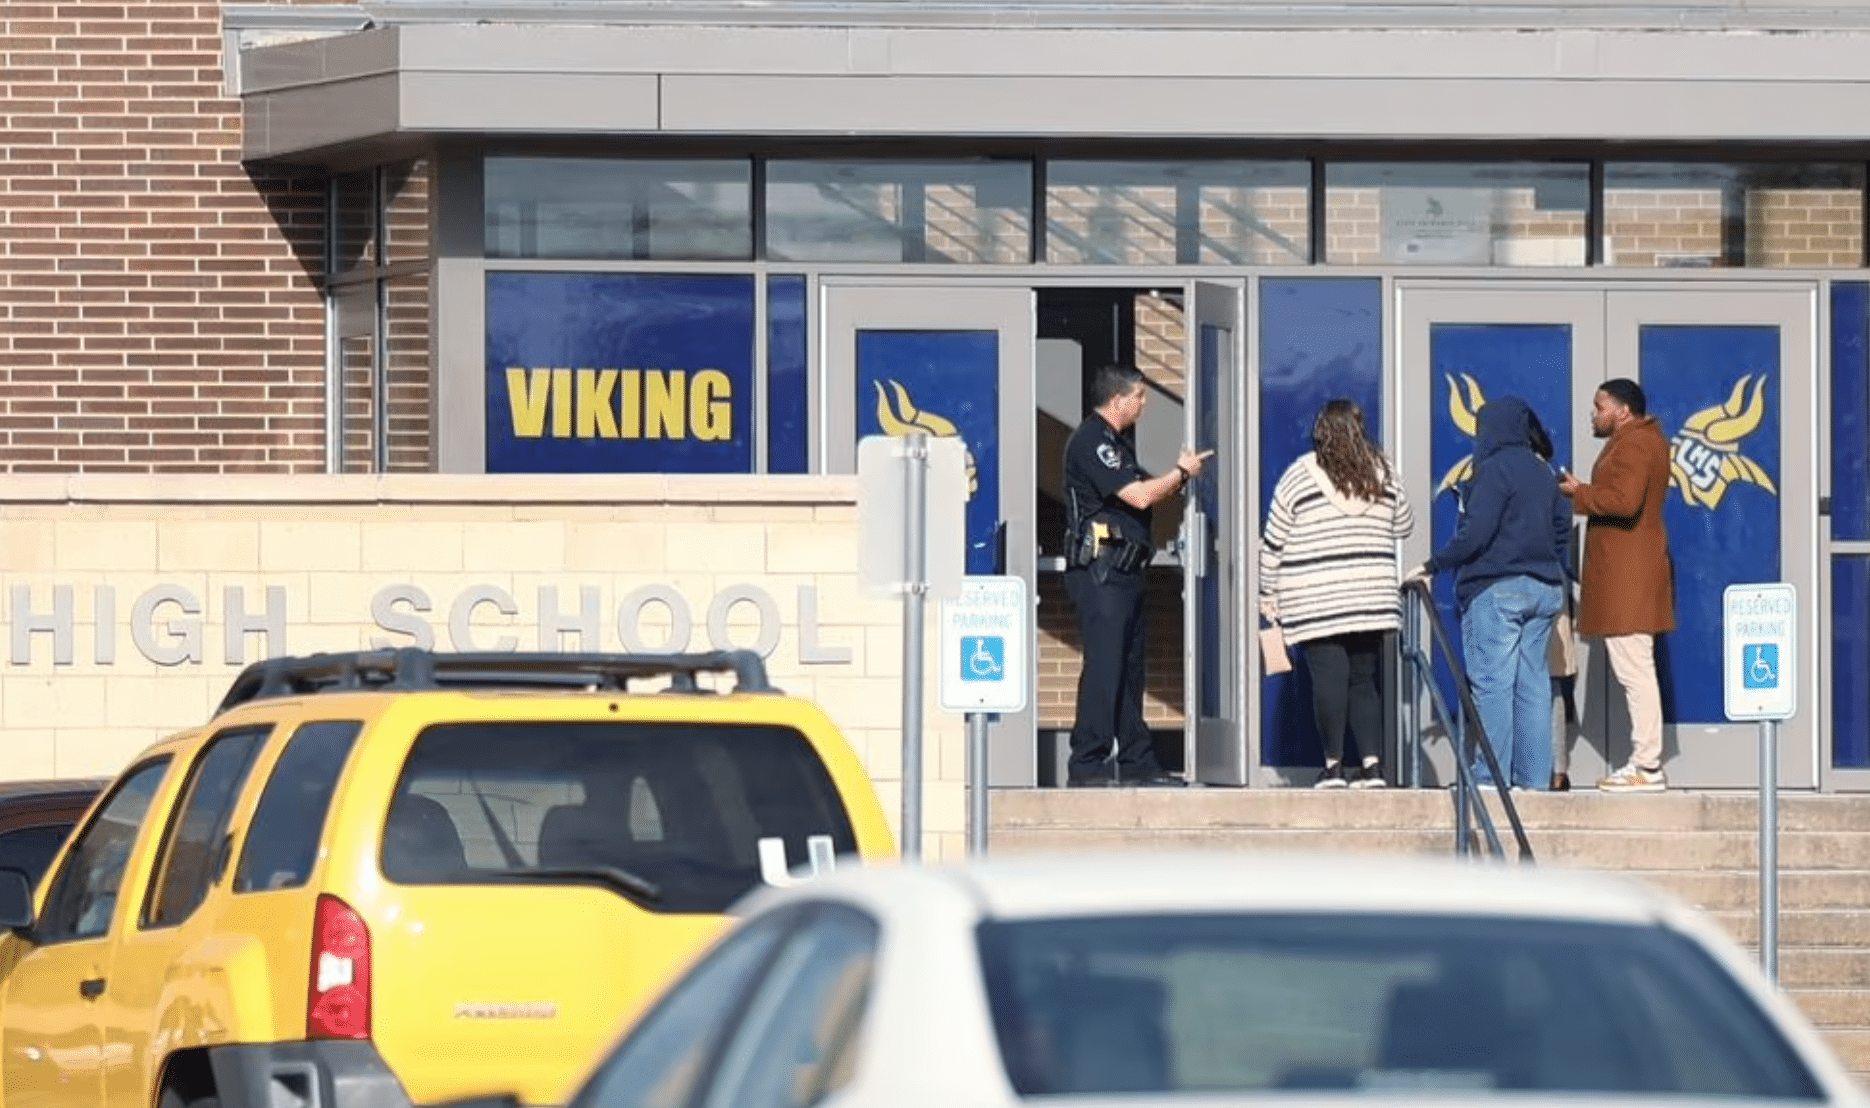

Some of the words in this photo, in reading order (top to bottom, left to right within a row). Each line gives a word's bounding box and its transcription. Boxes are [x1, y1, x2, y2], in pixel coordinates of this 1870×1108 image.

[505, 367, 732, 442] VIKING
[1730, 597, 1791, 615] RESERVED
[11, 583, 287, 666] HIGH
[370, 583, 853, 666] SCHOOL
[952, 612, 1013, 629] PARKING
[1735, 621, 1786, 638] PARKING
